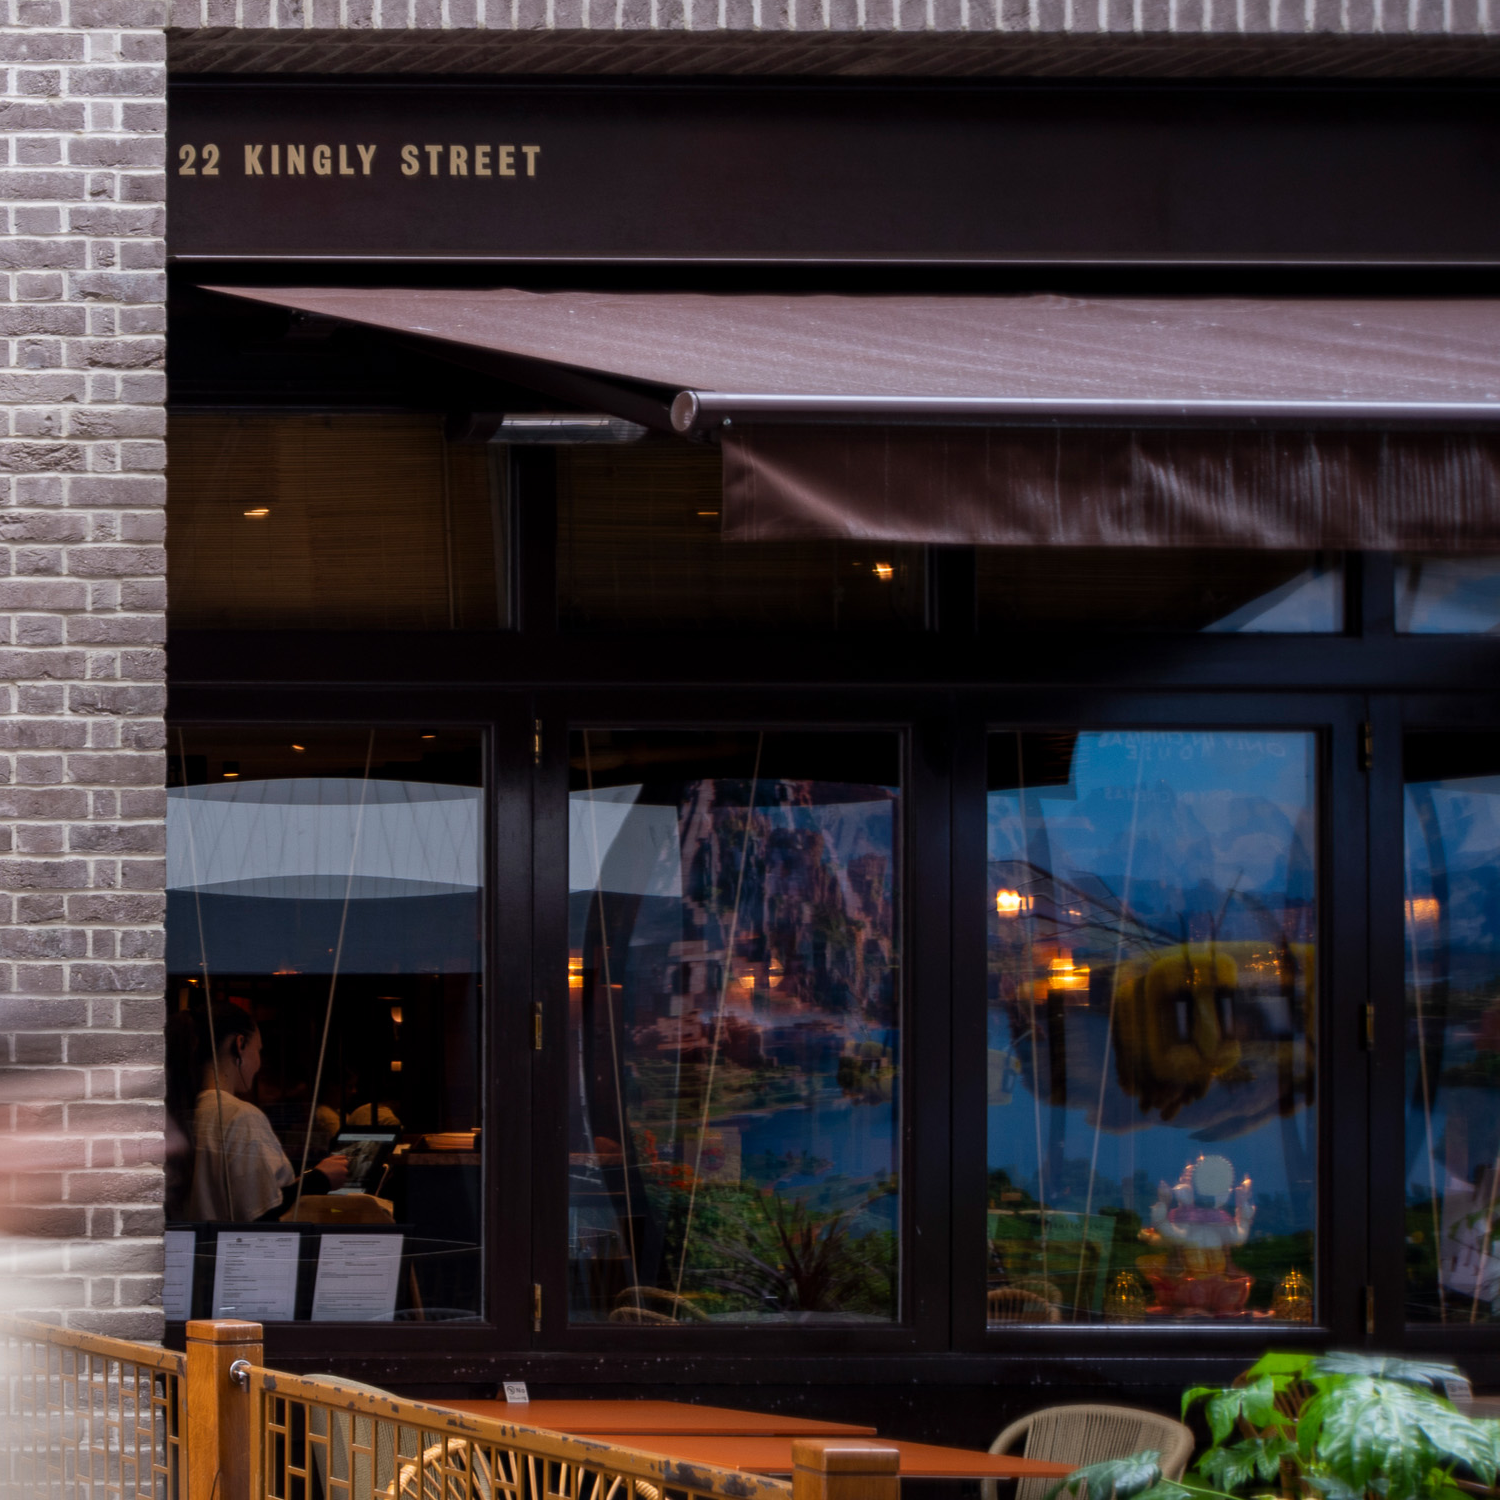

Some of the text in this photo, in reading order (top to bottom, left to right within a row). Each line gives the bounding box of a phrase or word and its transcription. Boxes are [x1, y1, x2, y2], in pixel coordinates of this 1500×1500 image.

[178, 143, 542, 178] 22 KINGLY STREET
